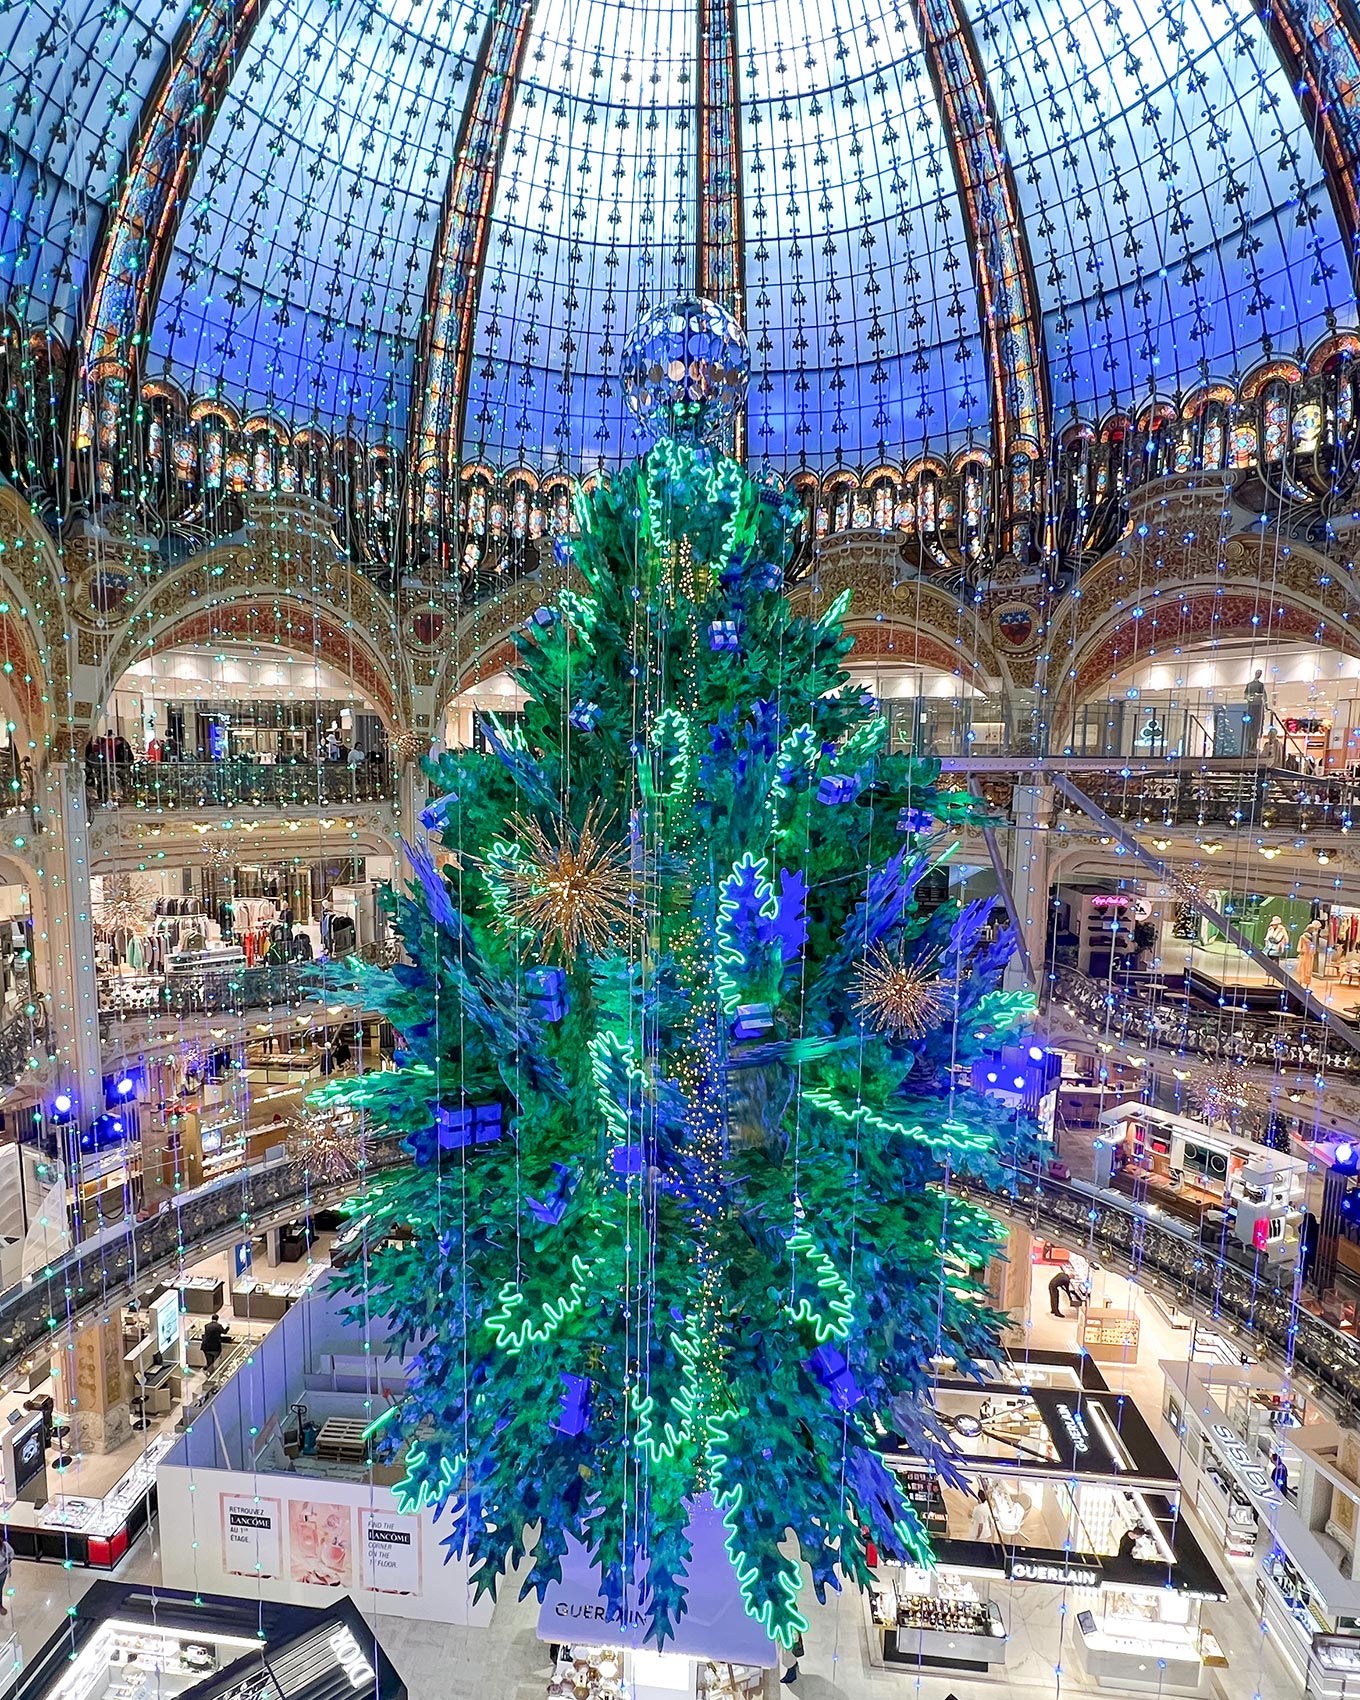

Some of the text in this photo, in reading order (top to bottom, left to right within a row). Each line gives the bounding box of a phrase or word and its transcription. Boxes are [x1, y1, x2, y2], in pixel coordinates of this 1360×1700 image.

[1212, 1424, 1283, 1506] sisley
[229, 1506, 264, 1516] RETROUVEZ
[230, 1515, 271, 1528] LANCÔME
[383, 1522, 395, 1530] THE
[369, 1531, 411, 1544] LANCÔME
[368, 1541, 393, 1551] CORNER
[368, 1550, 390, 1560] ON THE
[1012, 1563, 1097, 1586] GUERLAIN
[555, 1602, 647, 1626] GUERIN
[329, 1624, 376, 1689] DIOR
